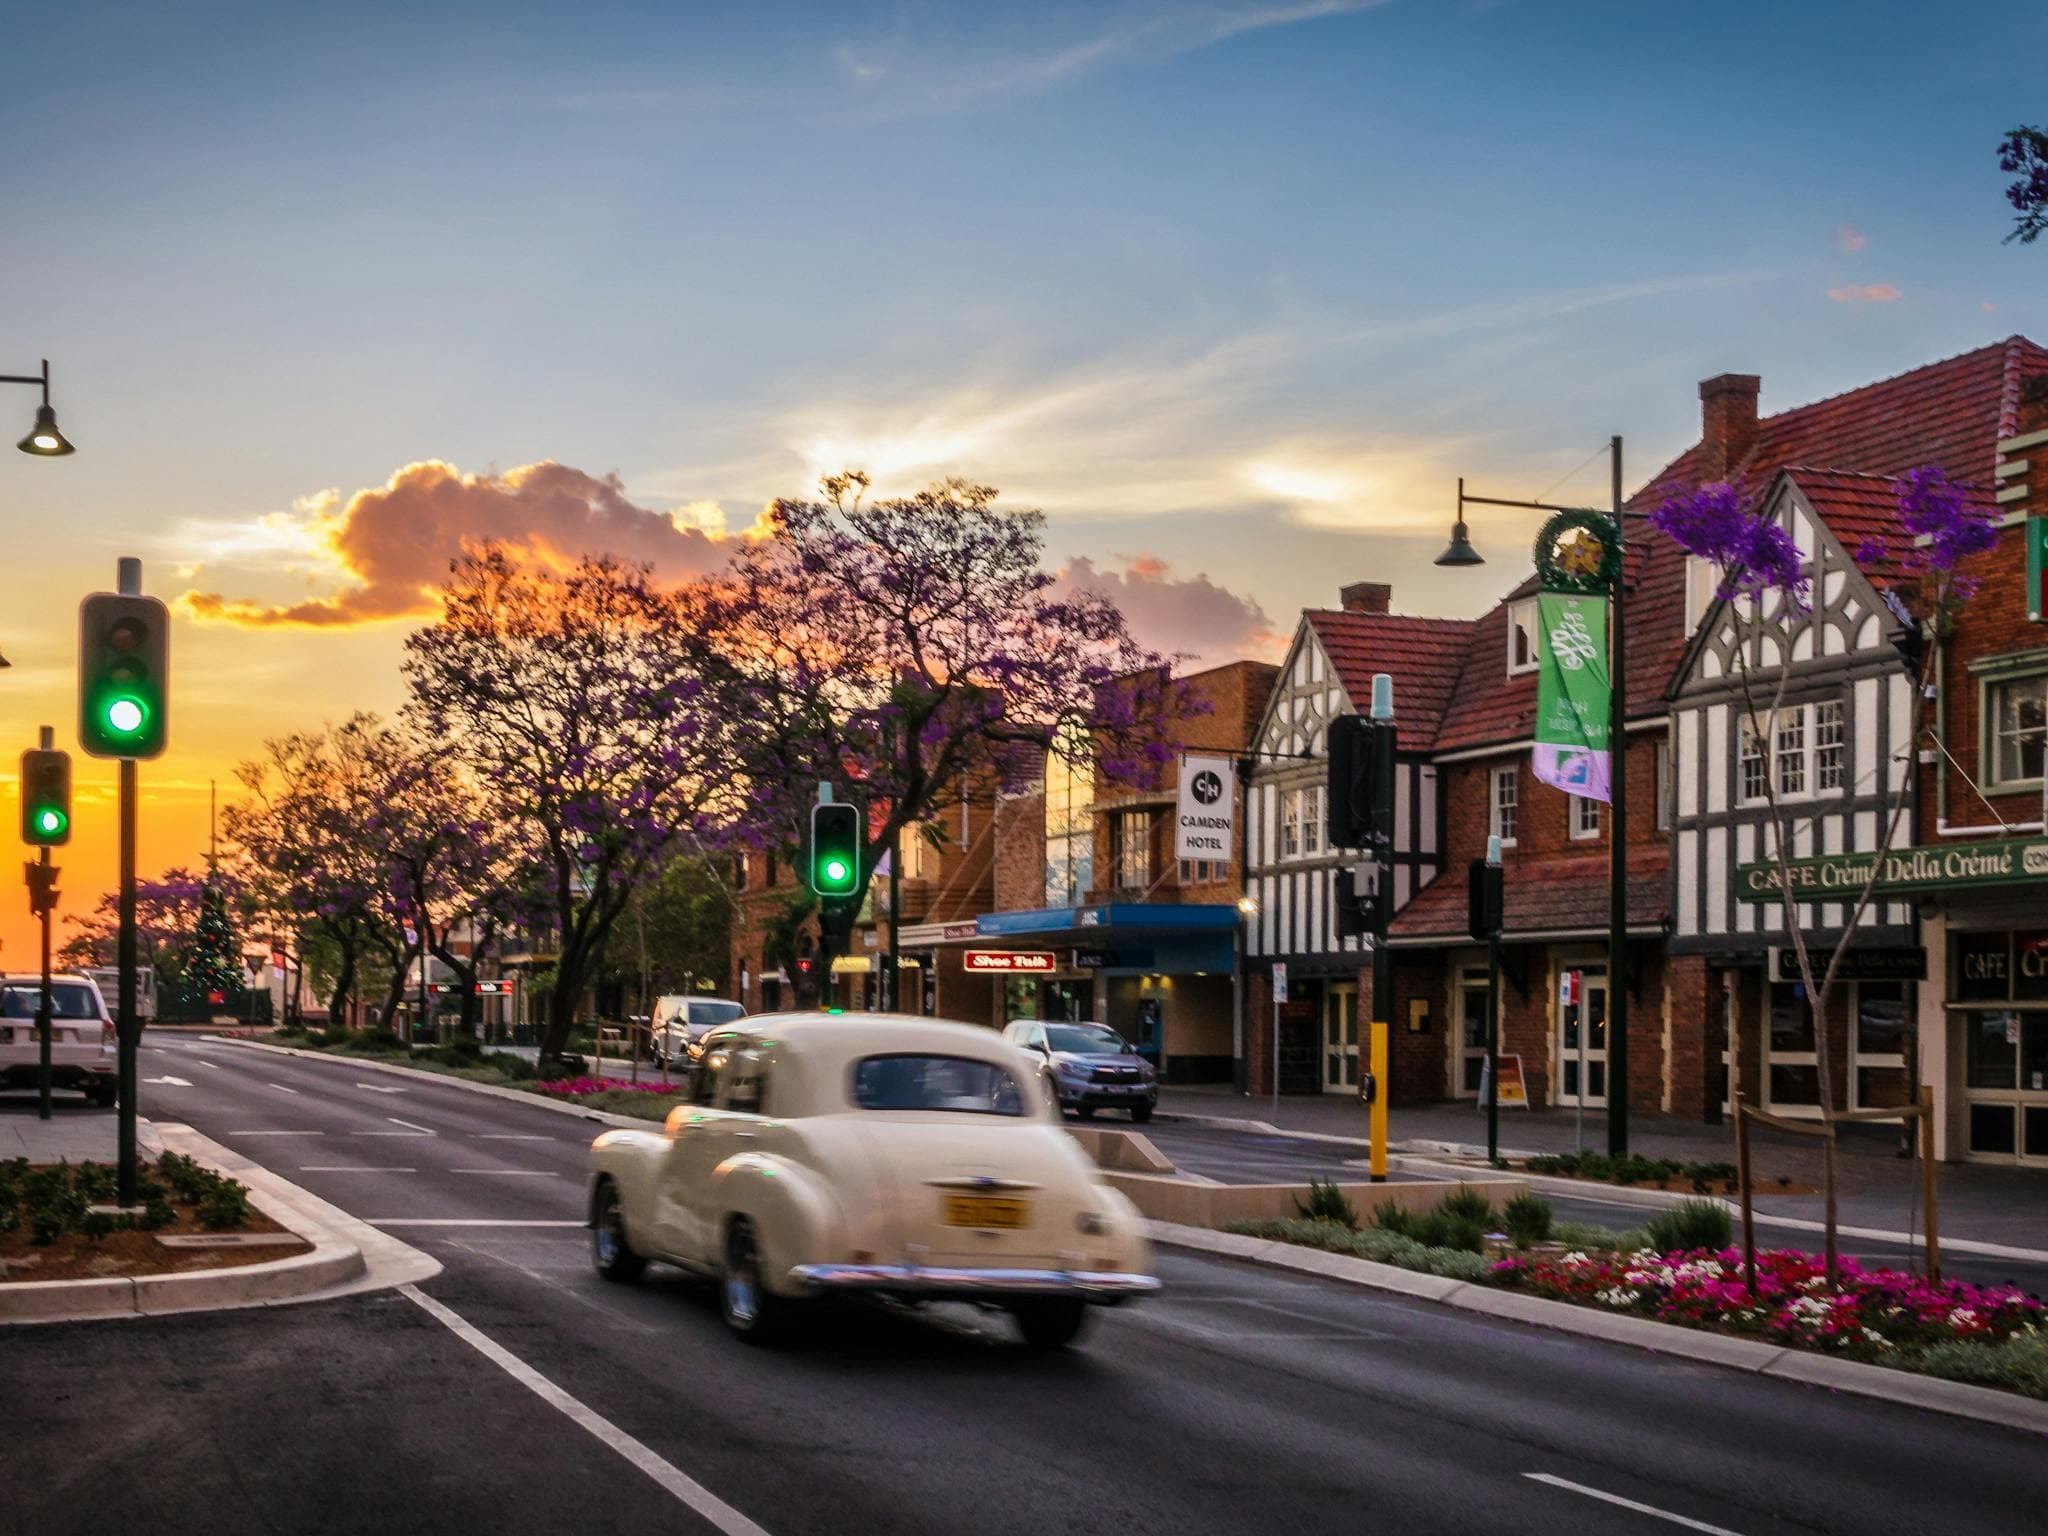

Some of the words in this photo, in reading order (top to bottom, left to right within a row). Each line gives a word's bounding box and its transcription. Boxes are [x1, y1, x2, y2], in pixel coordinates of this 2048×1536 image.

[1180, 815, 1231, 830] CAMDEN
[1186, 836, 1223, 850] HOTEL
[1748, 866, 1817, 890] CAFE
[1885, 850, 1942, 882] Della
[973, 955, 1011, 967] Shoe
[1013, 955, 1048, 967] Talk
[1784, 954, 1821, 968] CFE
[1965, 952, 2006, 979] CAFE
